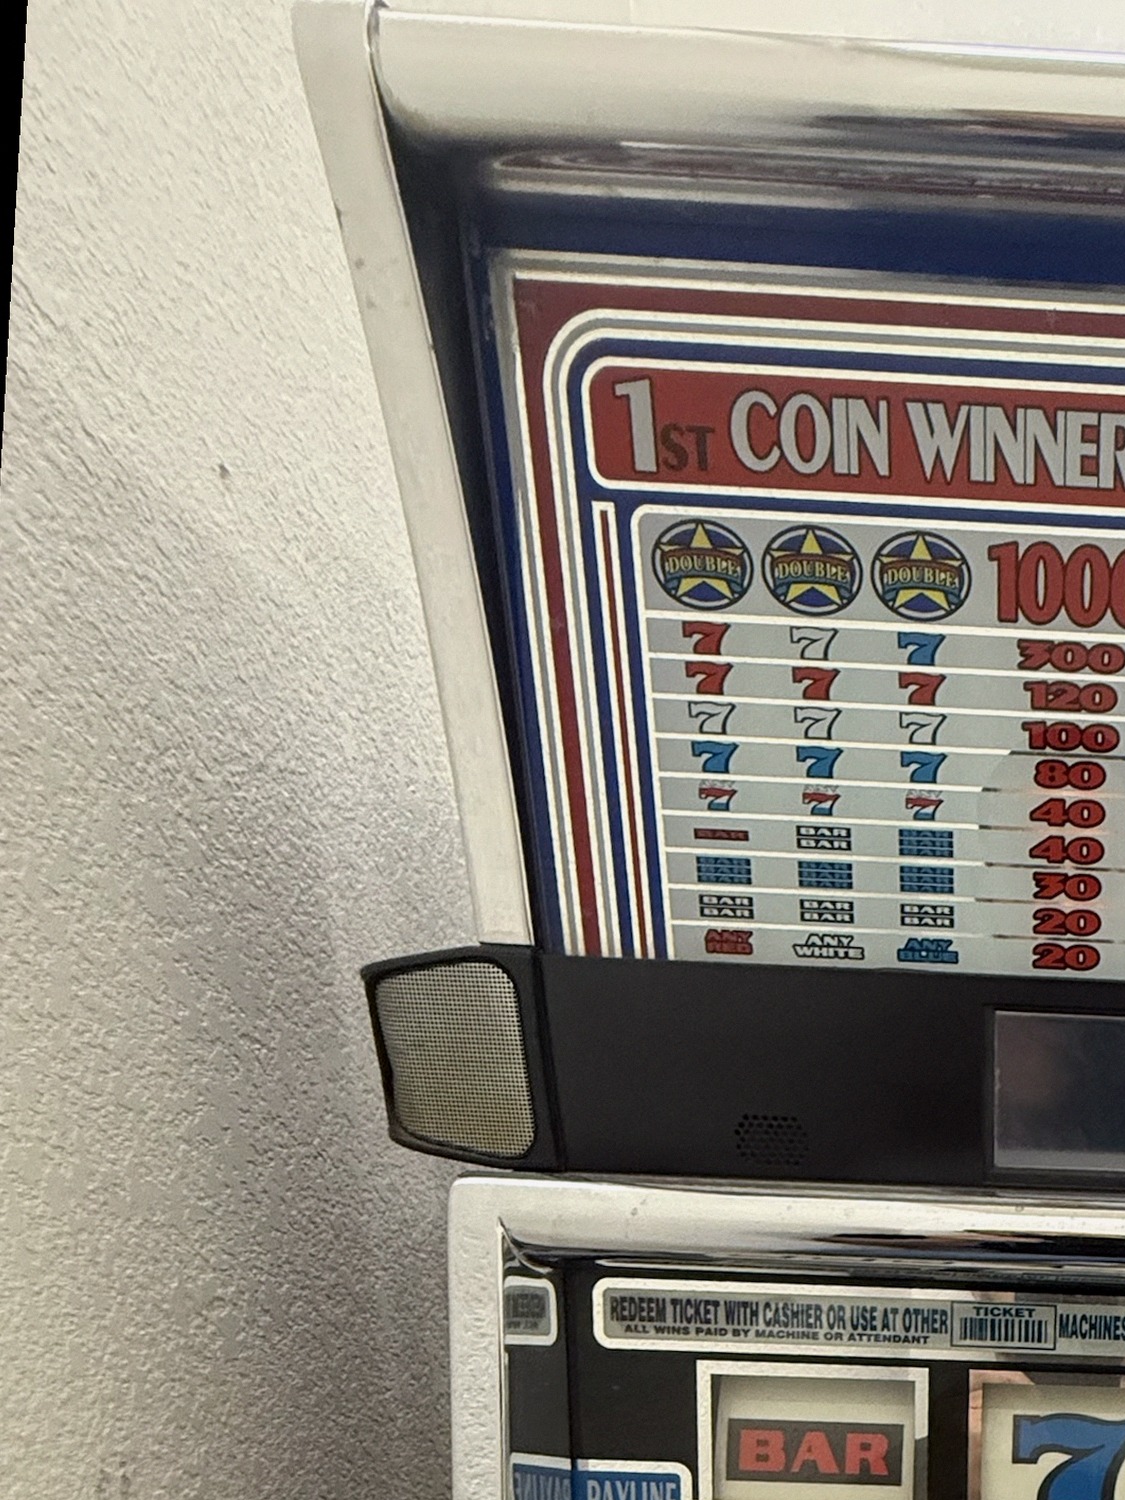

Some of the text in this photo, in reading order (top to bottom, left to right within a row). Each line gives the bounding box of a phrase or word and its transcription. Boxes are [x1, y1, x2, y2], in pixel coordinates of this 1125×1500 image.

[730, 388, 889, 478] COIN
[664, 555, 742, 577] DOUBLE
[774, 561, 852, 582] DOUBLE
[884, 566, 962, 589] DOUBLE
[682, 620, 731, 656] 7
[790, 626, 839, 661] 7
[897, 631, 946, 666] 7
[1022, 680, 1118, 714] 120
[1021, 720, 1120, 753] 100
[1033, 759, 1106, 791] 80
[1028, 798, 1106, 829] 40
[1028, 835, 1105, 866] 40
[1032, 871, 1102, 902] 30
[1031, 907, 1101, 937] 20
[705, 929, 1101, 972] ANY ANY ANY 20
[705, 941, 958, 964] RED WHITE BLUE
[610, 1296, 666, 1322] REDEEM
[670, 1298, 720, 1324] TICKET
[724, 1300, 759, 1327] WITH
[763, 1302, 823, 1330] CASHIER
[826, 1306, 846, 1329] OR
[851, 1306, 883, 1331] USE
[882, 1307, 899, 1332] AT
[902, 1308, 949, 1334] OTHER
[973, 1306, 1036, 1318] TICKET
[624, 1324, 930, 1345] ALL WINS PAID BY MACHINE OR ATTENDANT
[738, 1429, 889, 1477] BAR
